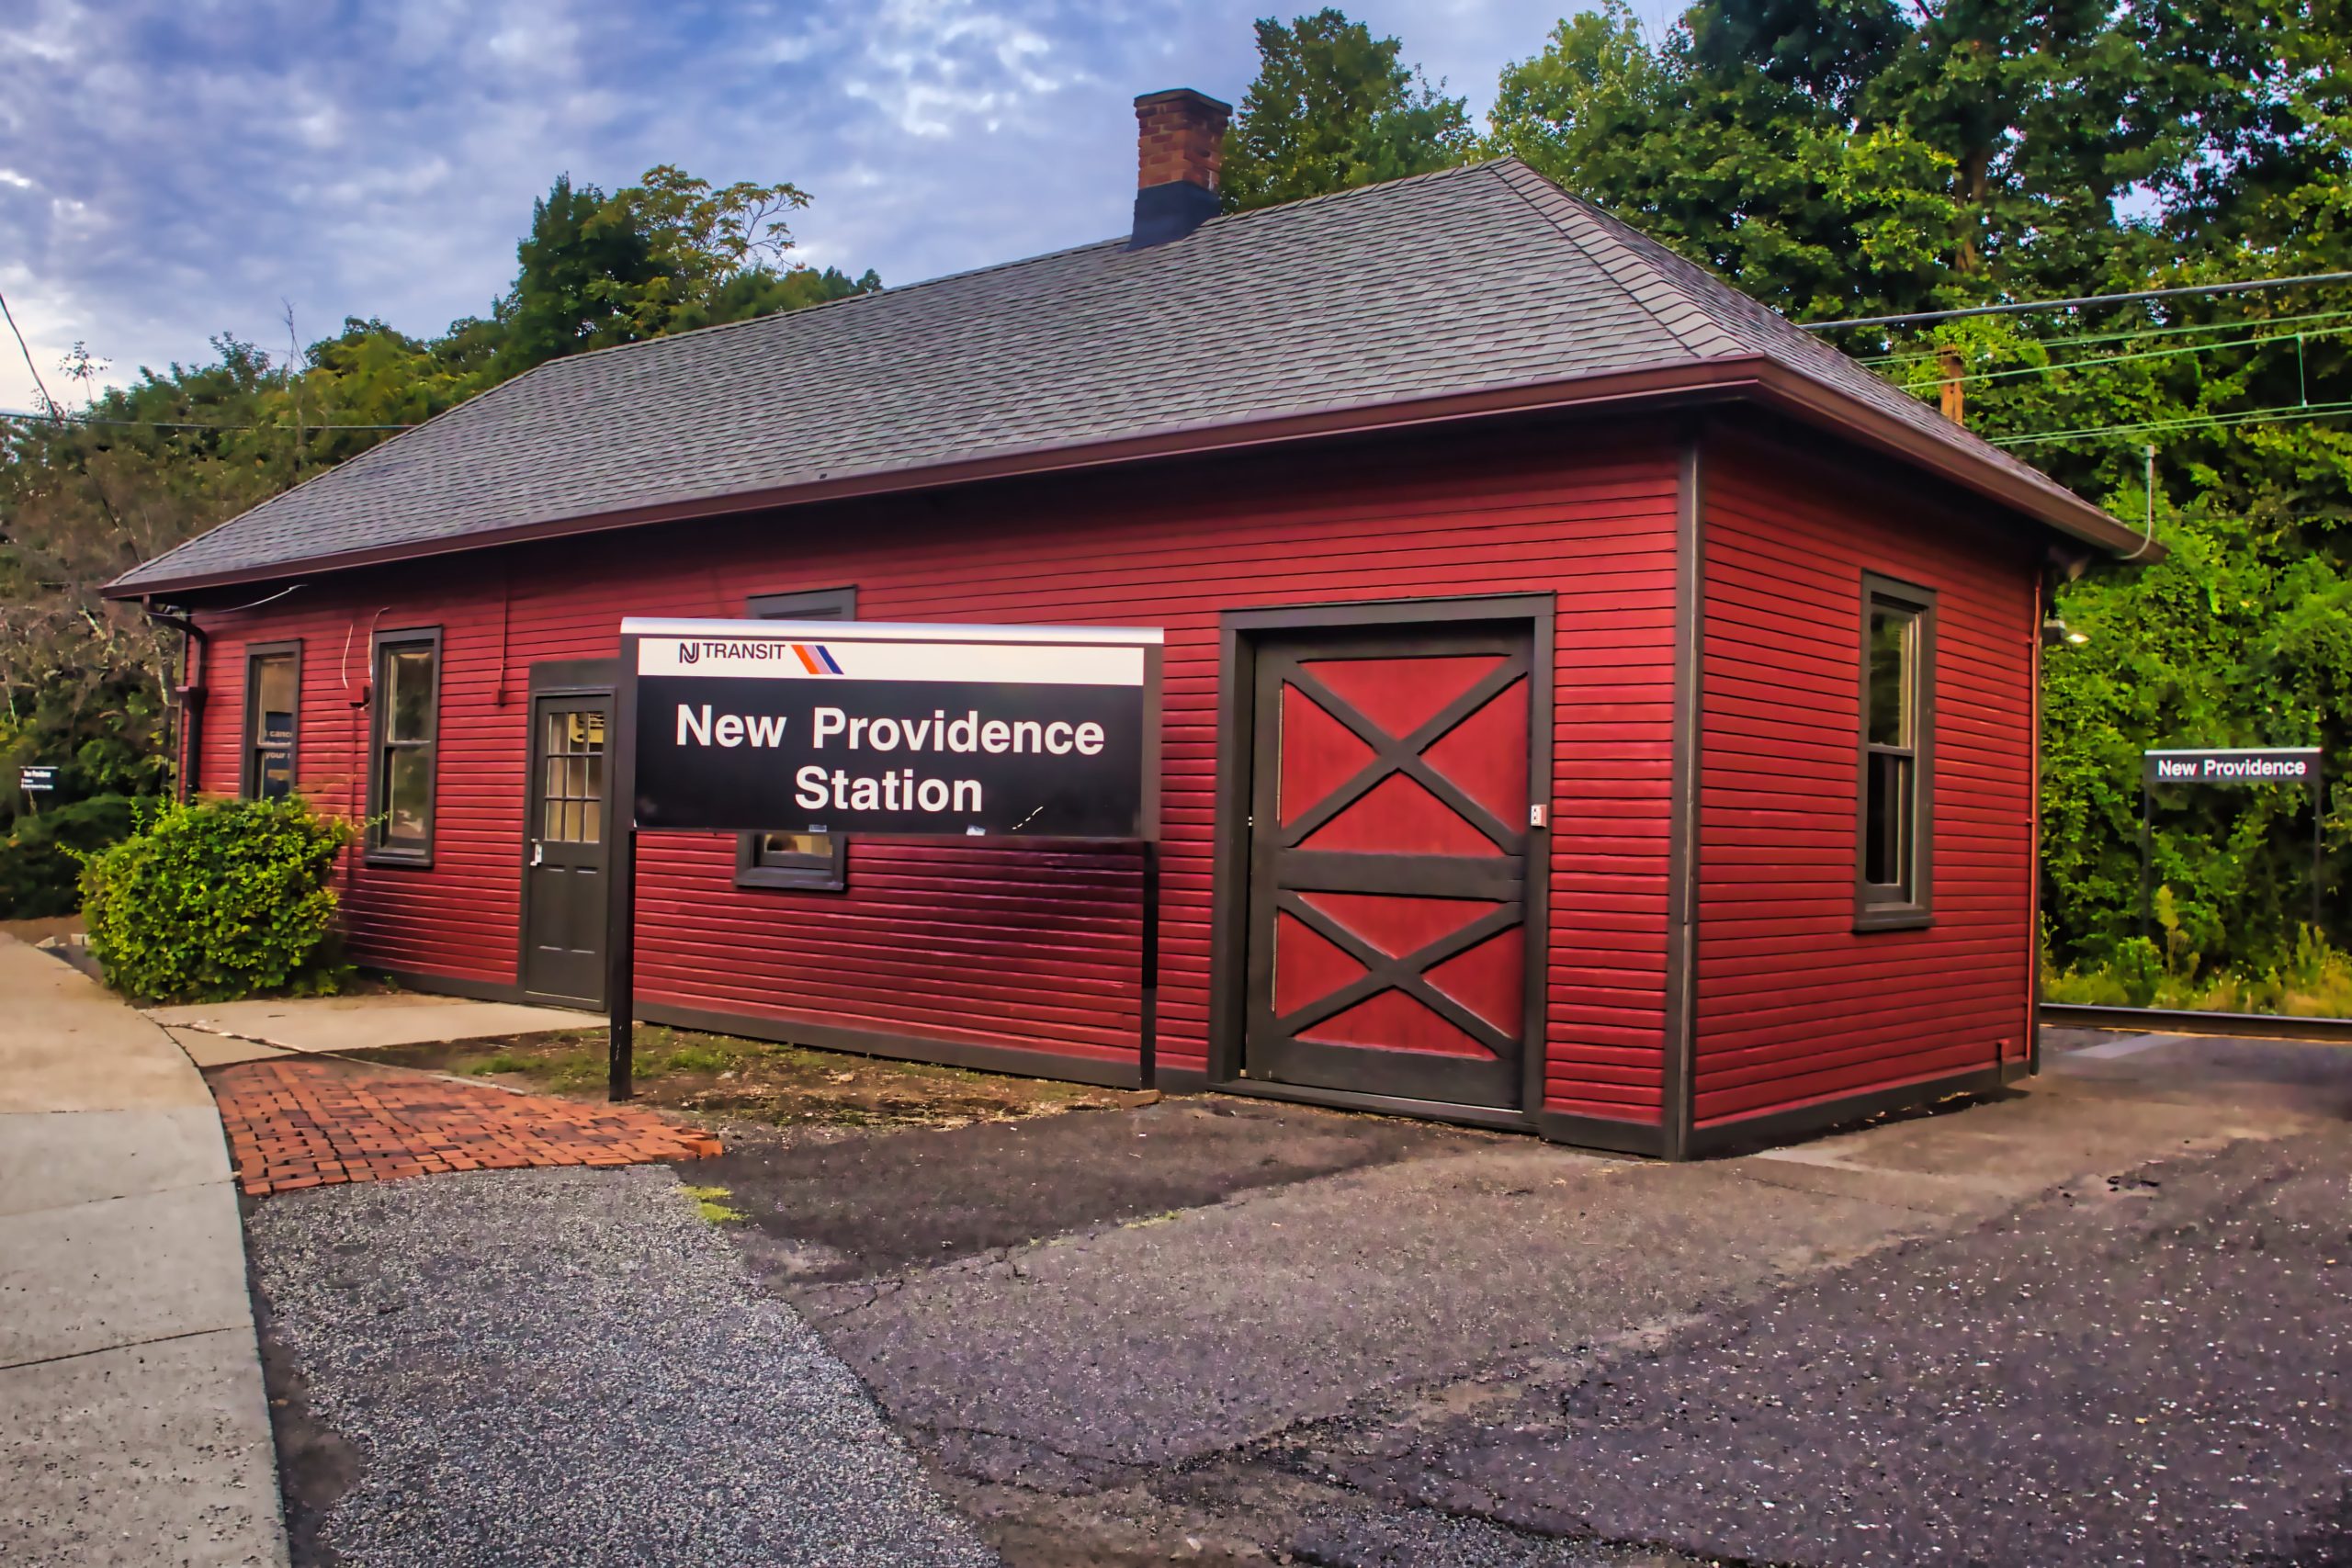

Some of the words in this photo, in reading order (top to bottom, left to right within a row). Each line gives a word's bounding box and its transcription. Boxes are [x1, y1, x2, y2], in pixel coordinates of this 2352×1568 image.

[679, 642, 700, 664] NJ
[703, 642, 786, 660] TRANSIT
[676, 704, 787, 748] New
[813, 706, 1104, 756] Providence
[2158, 760, 2198, 777] New
[2203, 758, 2307, 776] Providence
[795, 765, 982, 812] Station
